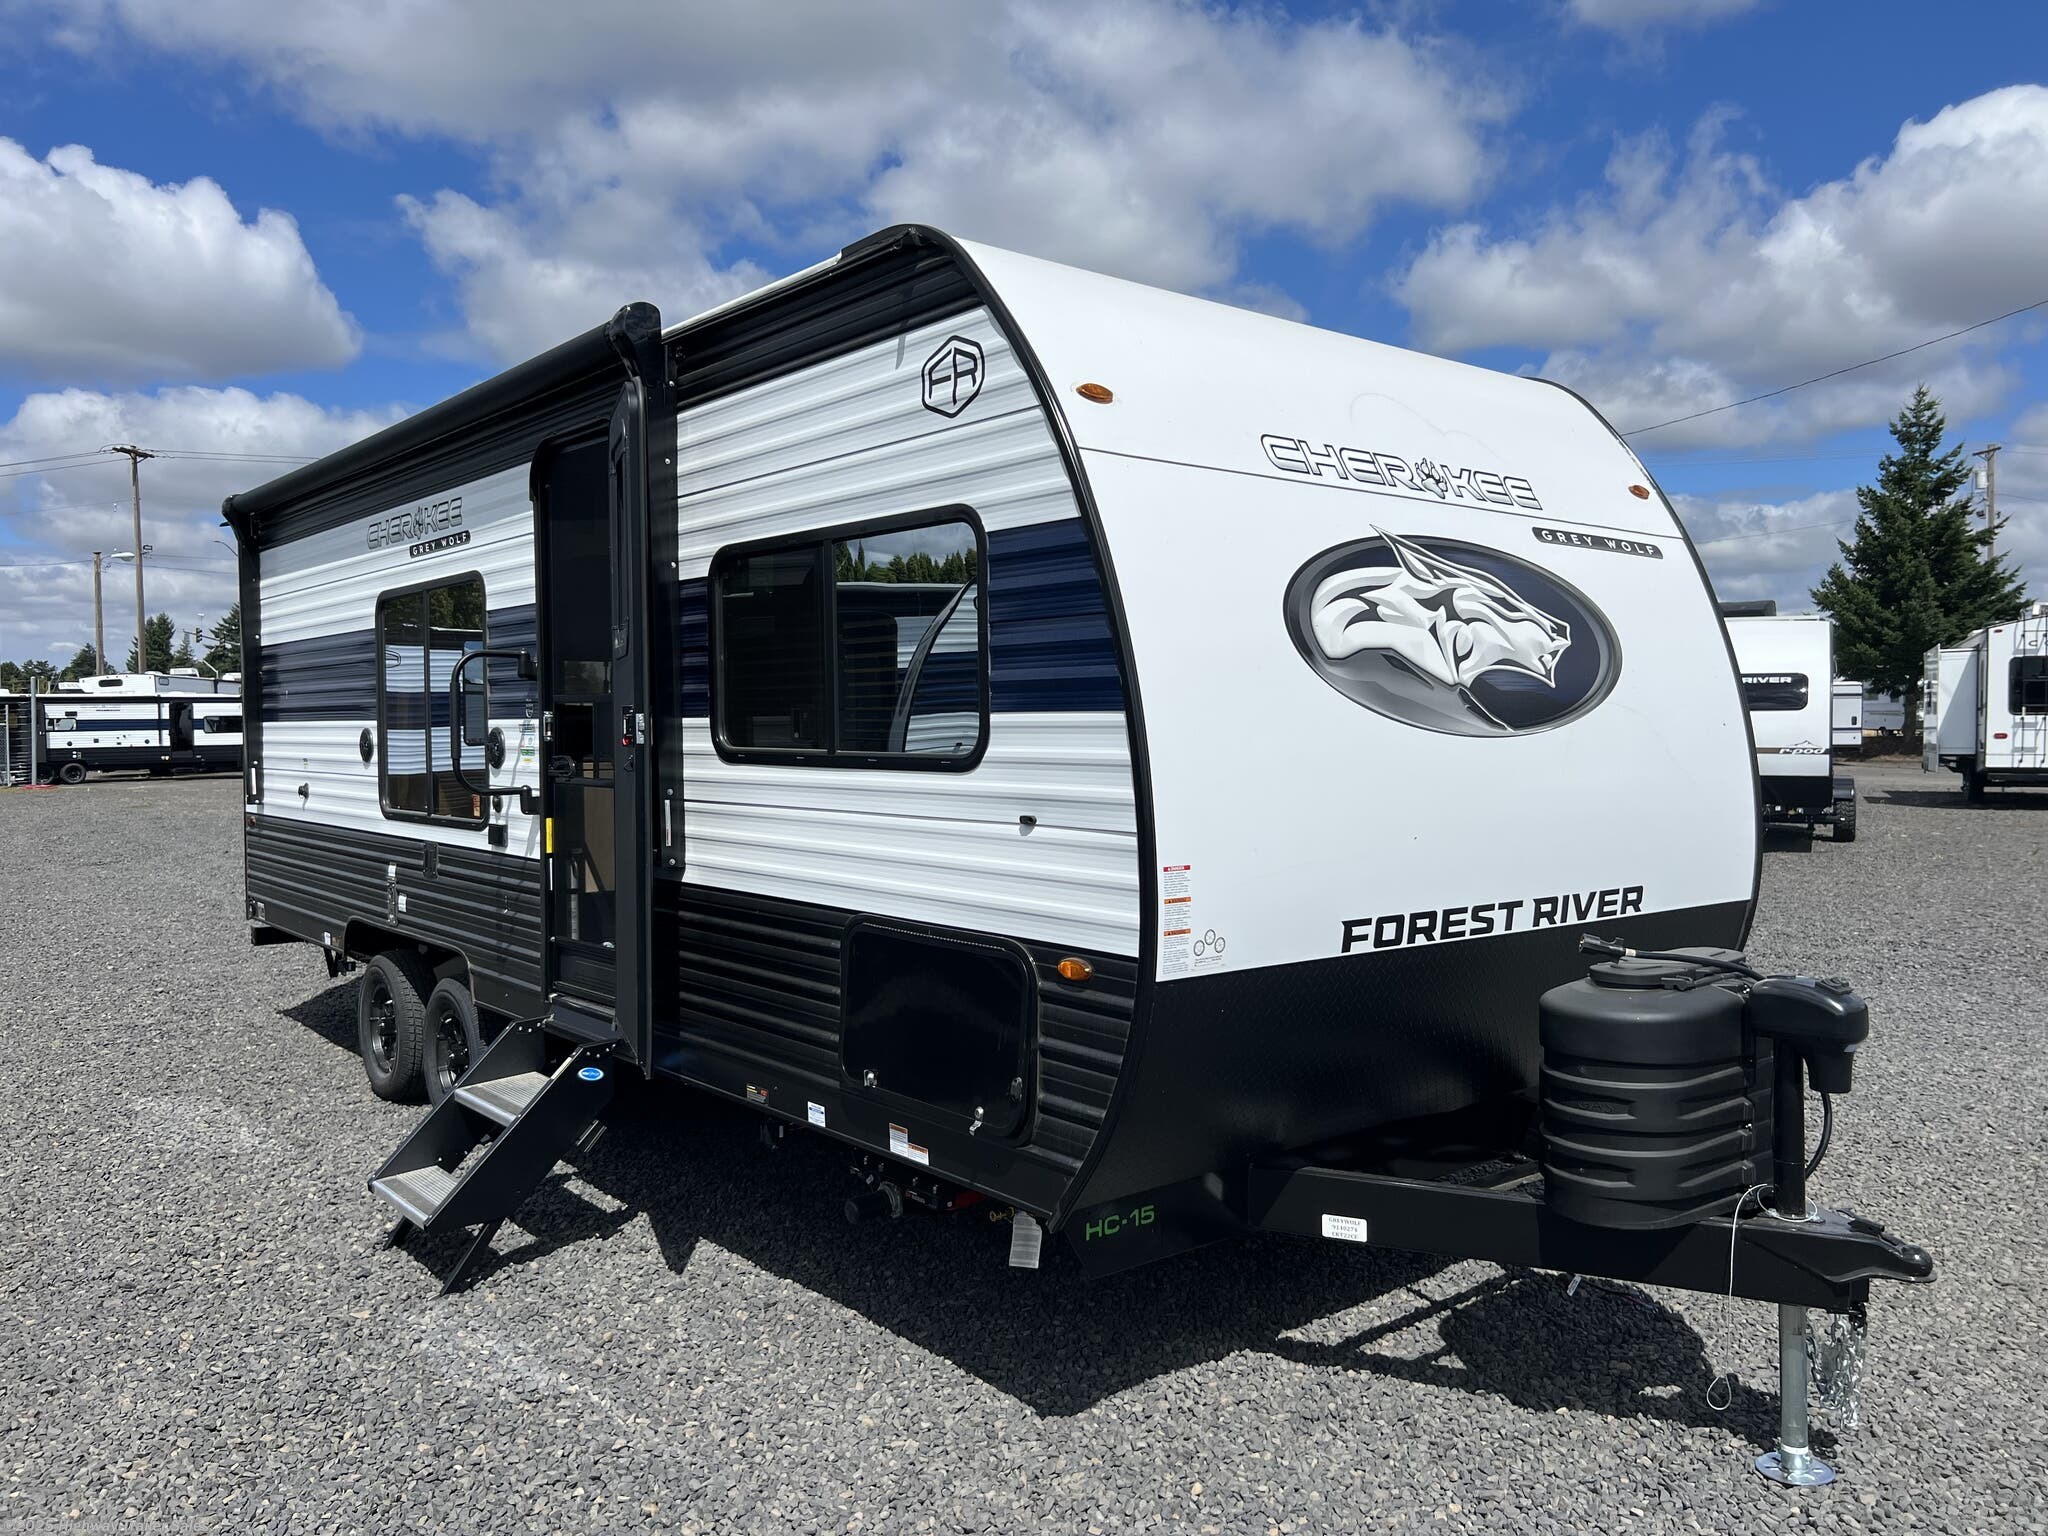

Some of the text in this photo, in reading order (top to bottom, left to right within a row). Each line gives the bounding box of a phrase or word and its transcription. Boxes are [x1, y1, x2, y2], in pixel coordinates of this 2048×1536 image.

[412, 532, 467, 555] GREY WOLF
[1541, 529, 1656, 556] GREY WOLF
[1741, 676, 1792, 684] RIVER
[1340, 885, 1645, 954] FOREST RIVER
